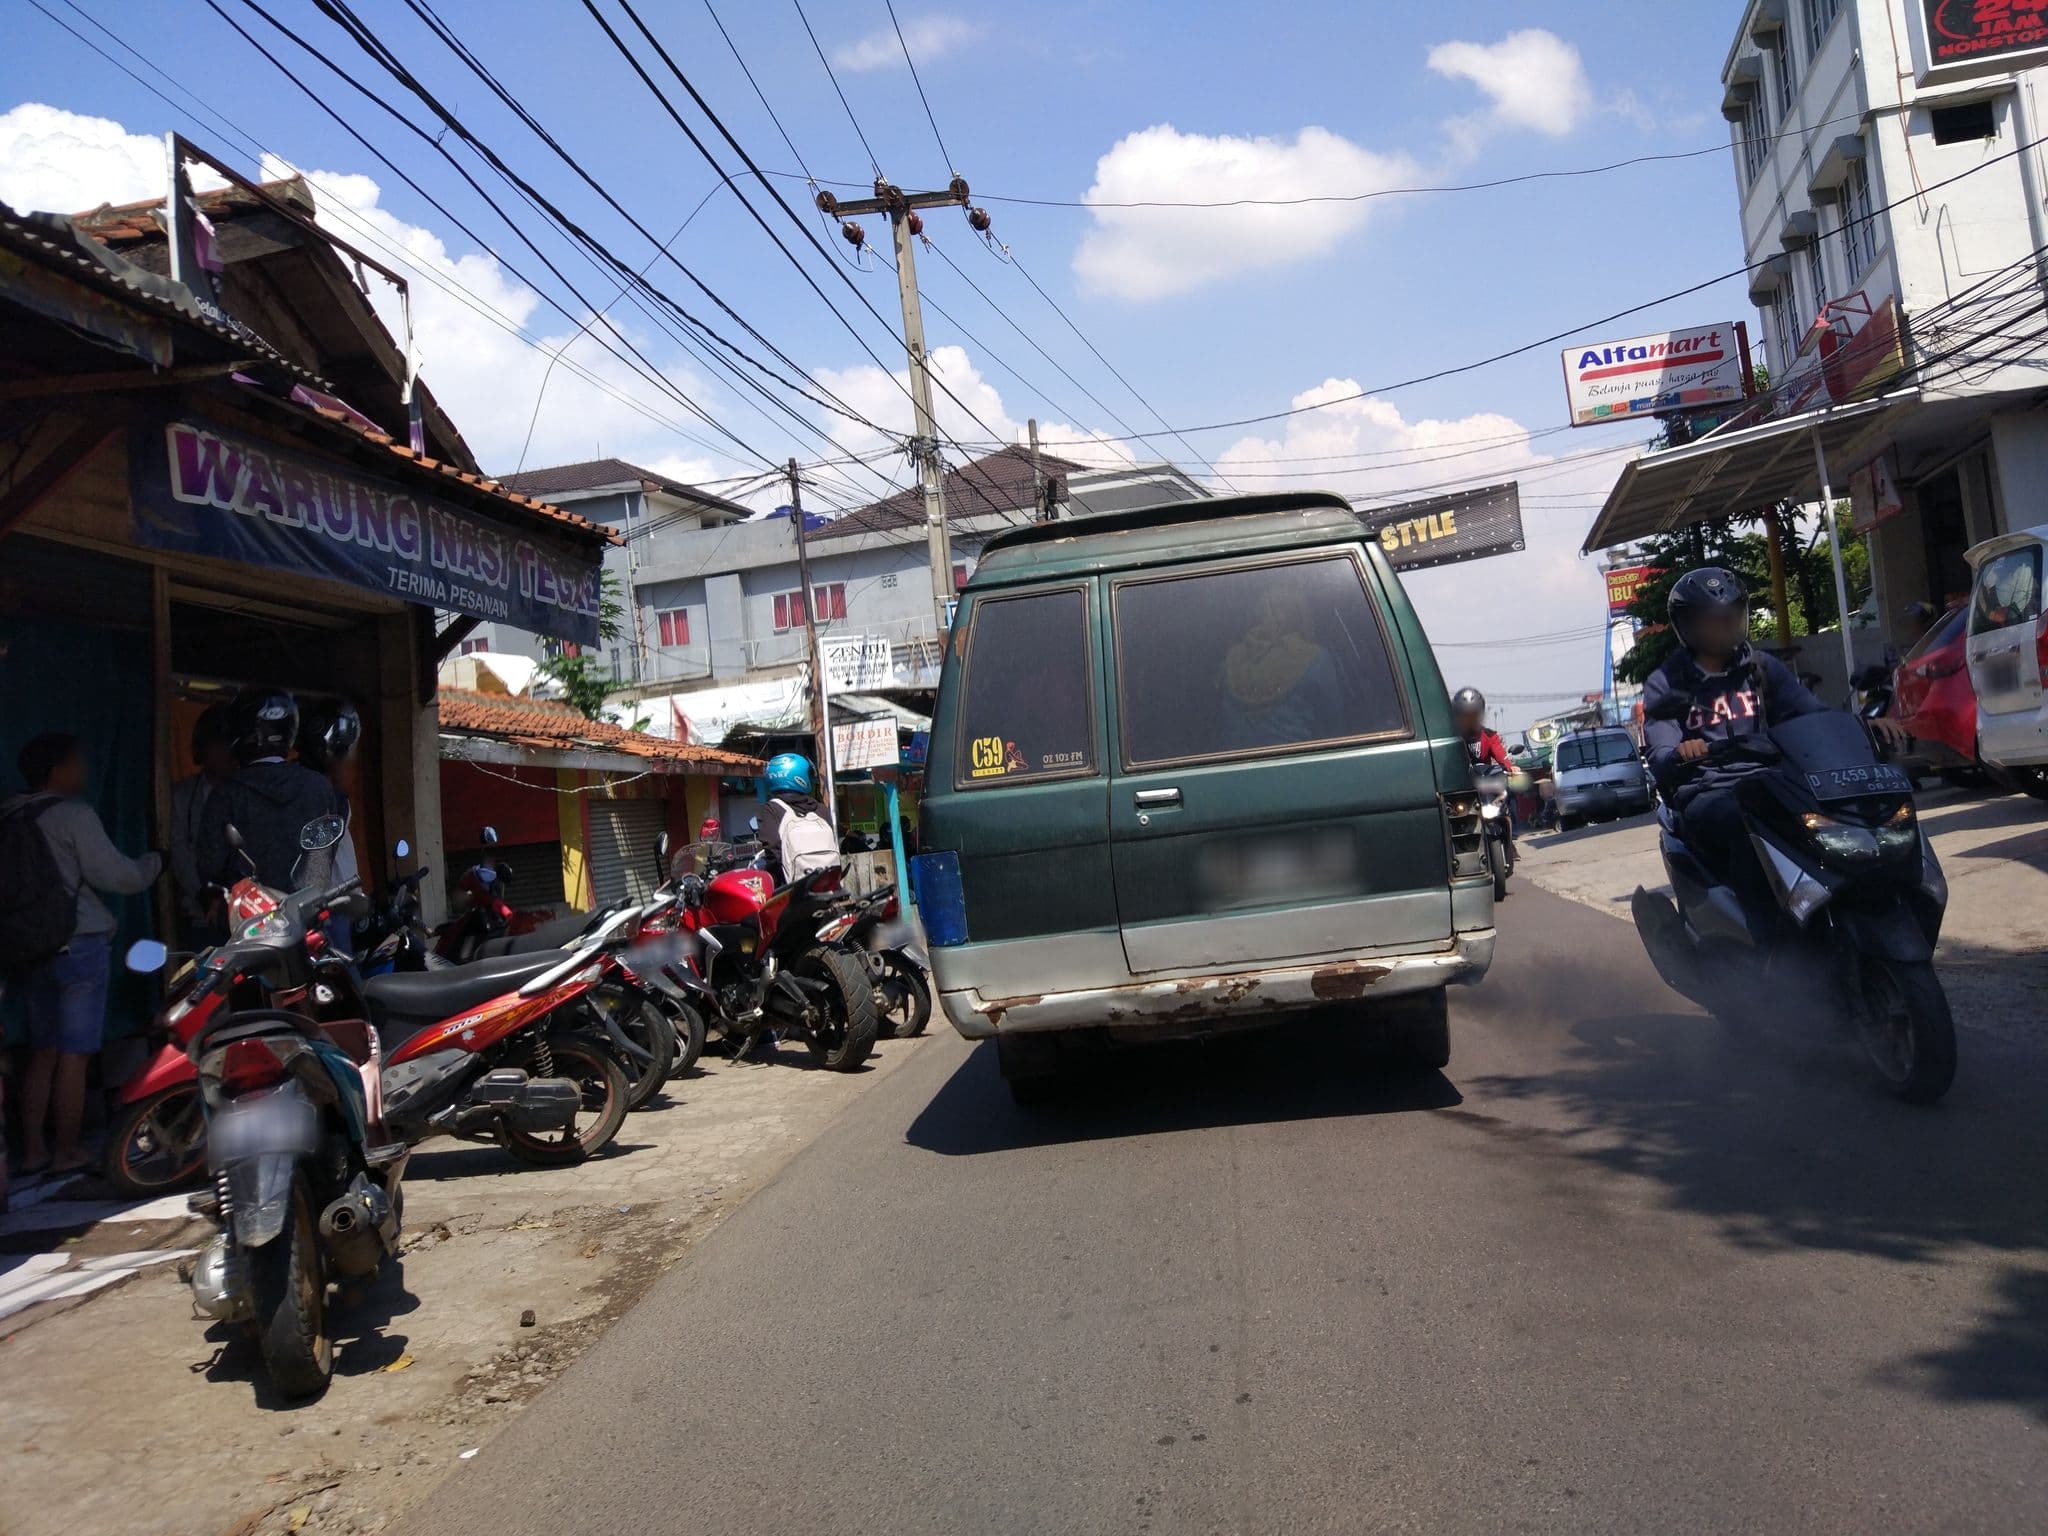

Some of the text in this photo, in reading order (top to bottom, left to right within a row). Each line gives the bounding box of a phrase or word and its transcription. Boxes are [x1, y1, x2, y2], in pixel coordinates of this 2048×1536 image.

[1976, 13, 2044, 37] JAM
[1938, 28, 2048, 56] NONSTOP
[1578, 331, 1722, 369] Alfamart
[1588, 383, 1631, 397] Belanja
[166, 423, 422, 561] WARUNG
[428, 505, 511, 591] NASI
[1380, 510, 1458, 550] STYLE
[388, 566, 508, 618] TERIMA PESANAN
[1608, 585, 1632, 602] IBU
[838, 728, 892, 743] BORDIR
[972, 736, 1003, 768] C59
[1070, 751, 1083, 762] FM
[1809, 775, 1821, 787] D
[1830, 768, 1869, 784] 2459
